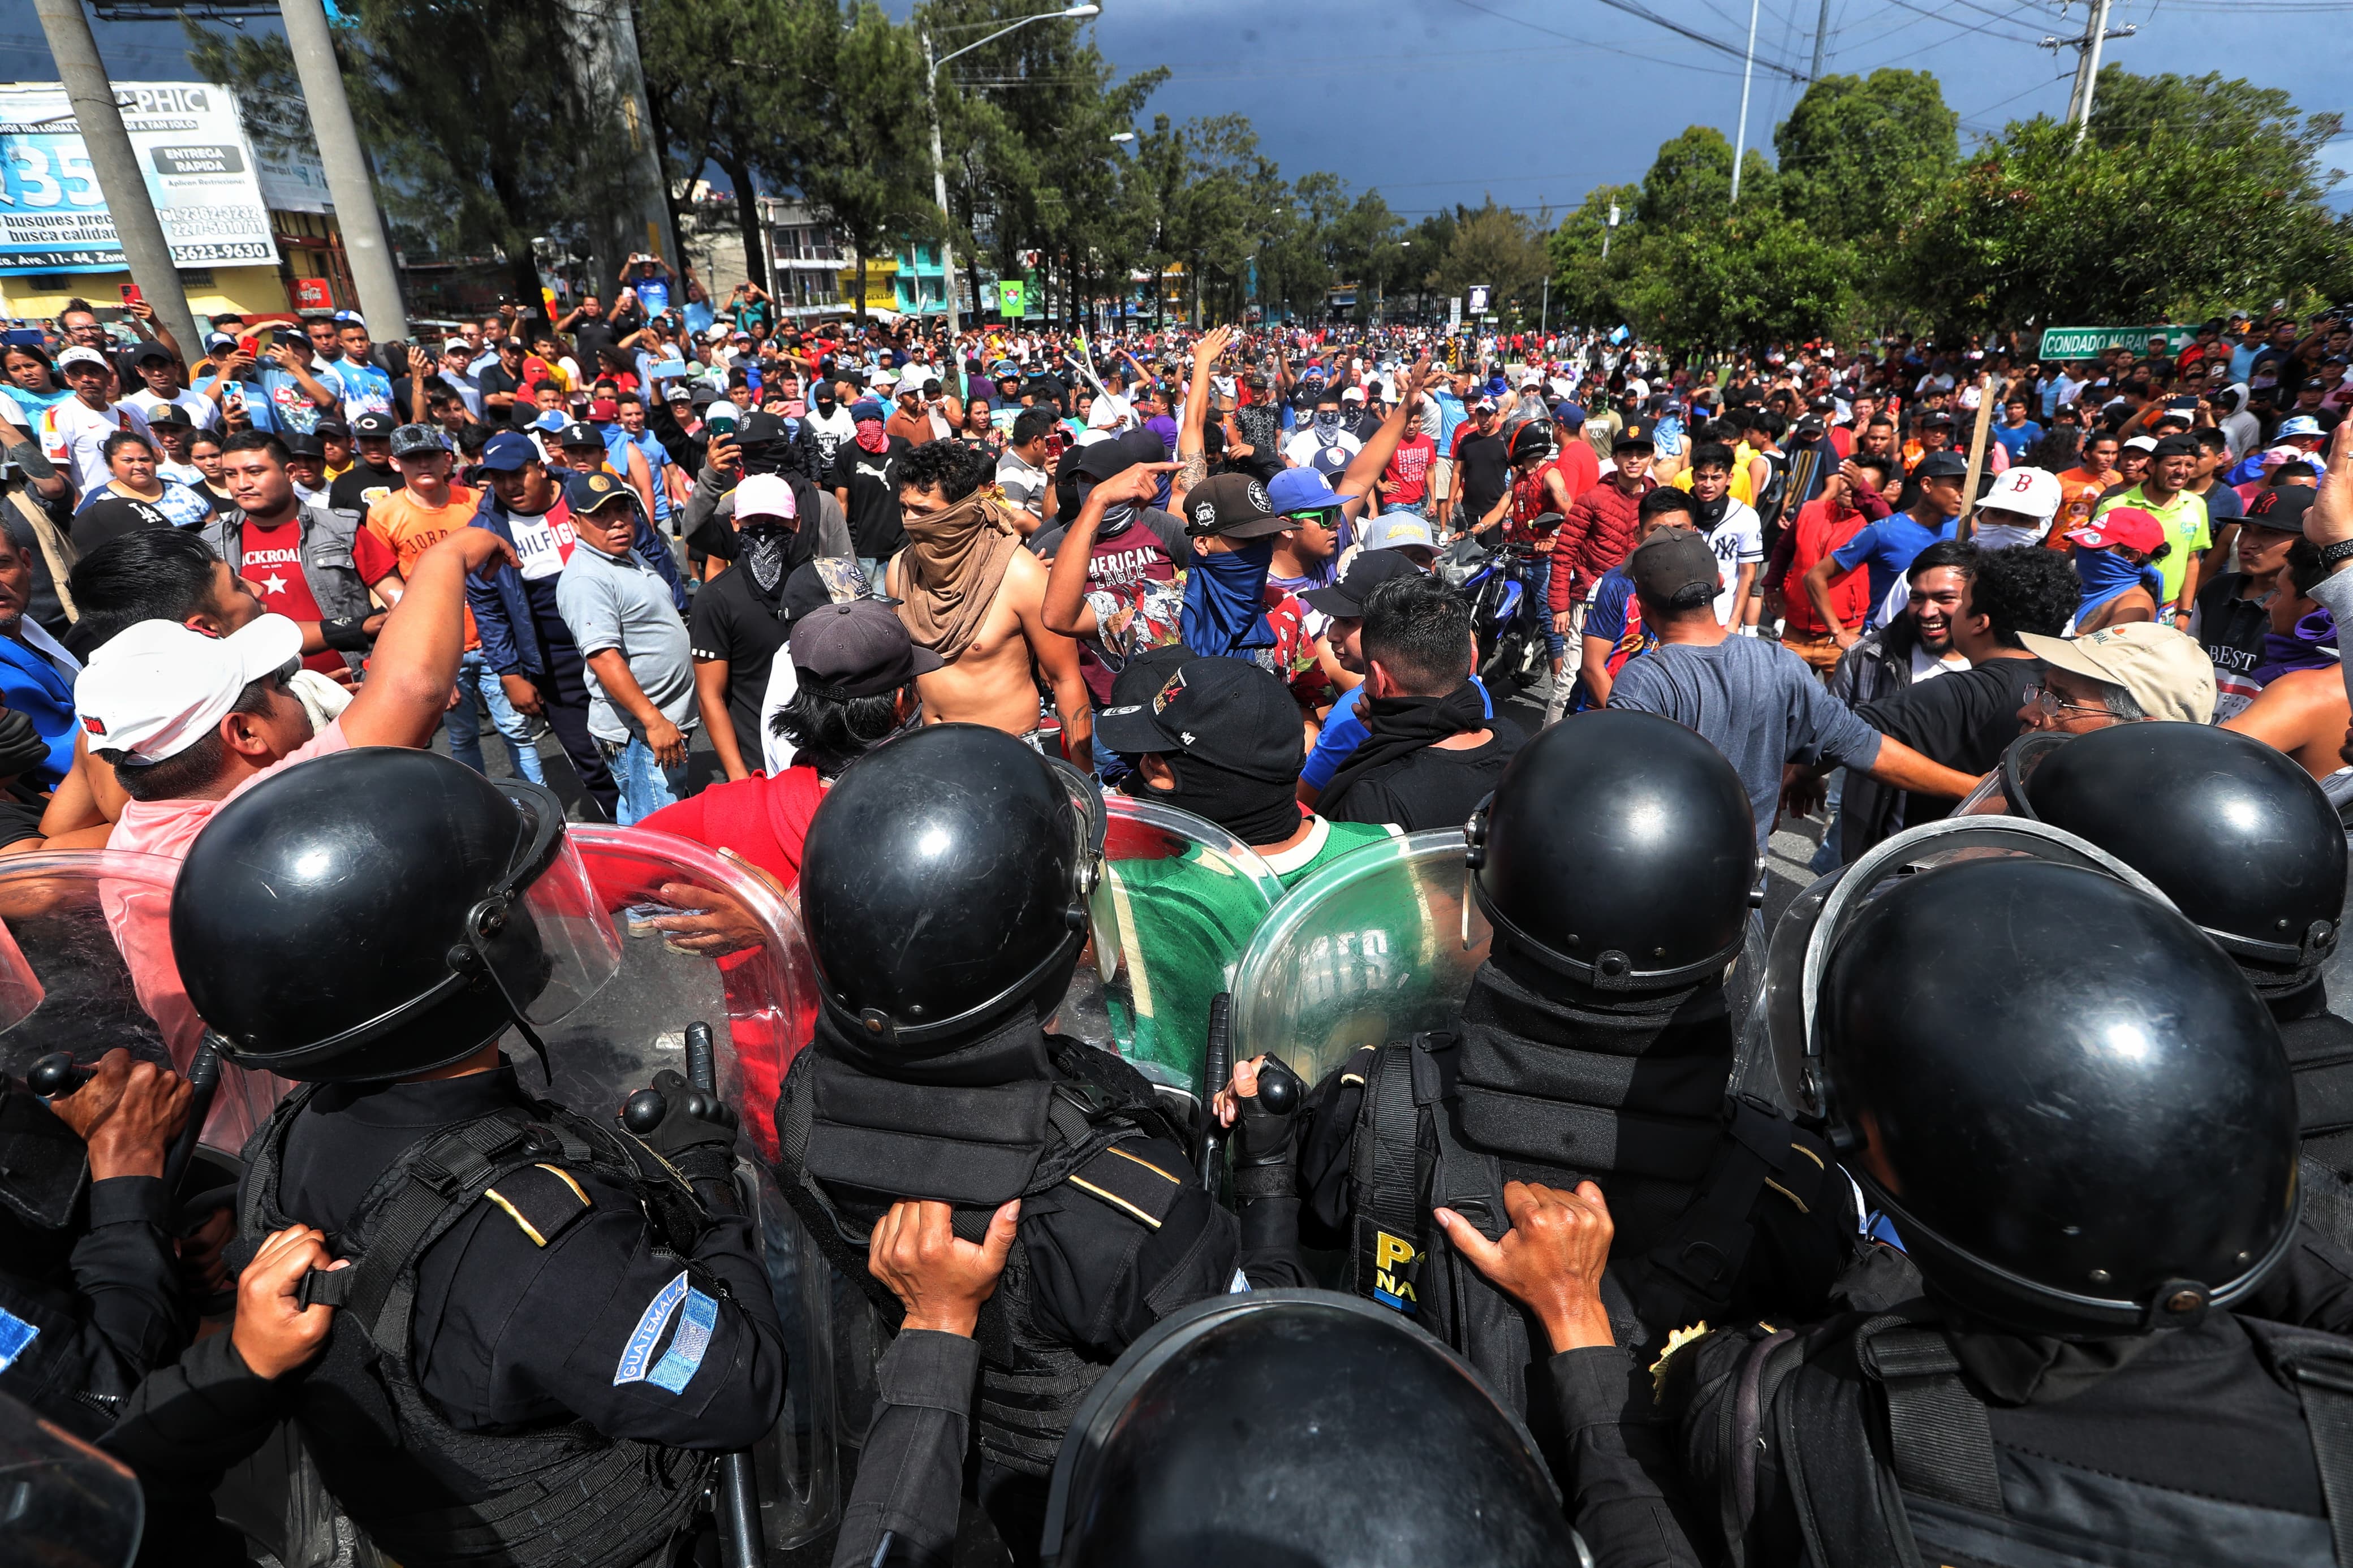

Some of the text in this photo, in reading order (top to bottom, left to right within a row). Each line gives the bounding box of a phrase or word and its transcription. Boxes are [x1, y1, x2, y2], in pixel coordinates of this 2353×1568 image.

[137, 122, 145, 130] A
[146, 121, 169, 129] TAN
[163, 148, 225, 159] ENTREGA
[174, 161, 226, 172] RAPIDA
[3, 214, 74, 228] busques
[180, 205, 261, 222] 2362-3232
[8, 230, 59, 243] busca
[171, 219, 265, 236] 2277-5910/11
[18, 254, 47, 266] Ave.
[175, 243, 266, 261] 5623-9630
[2045, 335, 2106, 353] CONDADO
[2010, 473, 2032, 493] B
[1714, 534, 1738, 560] NY
[1091, 565, 1147, 589] EAGLE
[2208, 645, 2257, 671] BEST
[1376, 1230, 1426, 1272] P
[1376, 1269, 1417, 1302] NA
[623, 1284, 684, 1377] GUATEMALA
